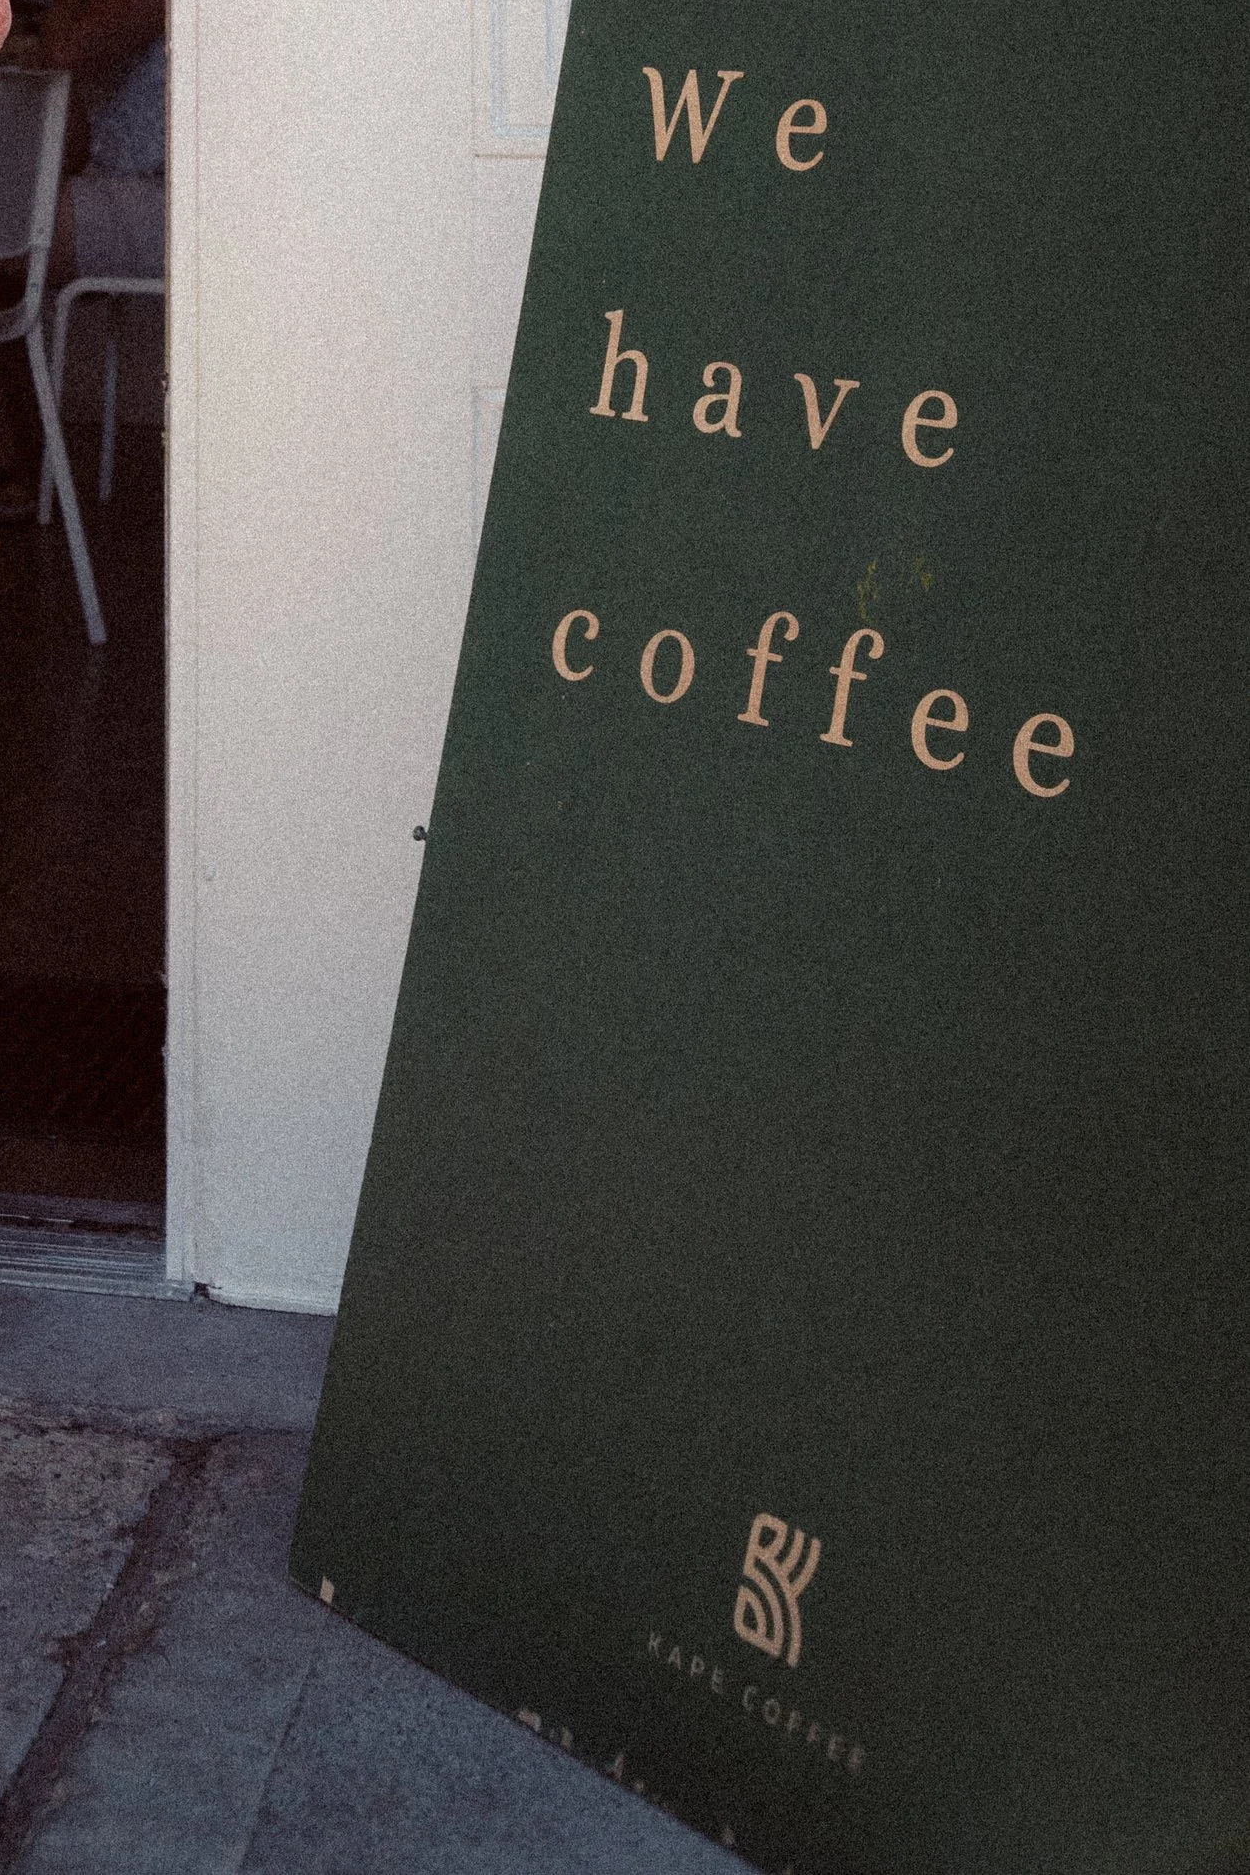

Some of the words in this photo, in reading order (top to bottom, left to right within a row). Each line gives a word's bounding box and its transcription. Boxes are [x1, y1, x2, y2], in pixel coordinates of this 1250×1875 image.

[642, 66, 830, 171] We
[589, 309, 959, 467] have
[552, 608, 1076, 798] coffee
